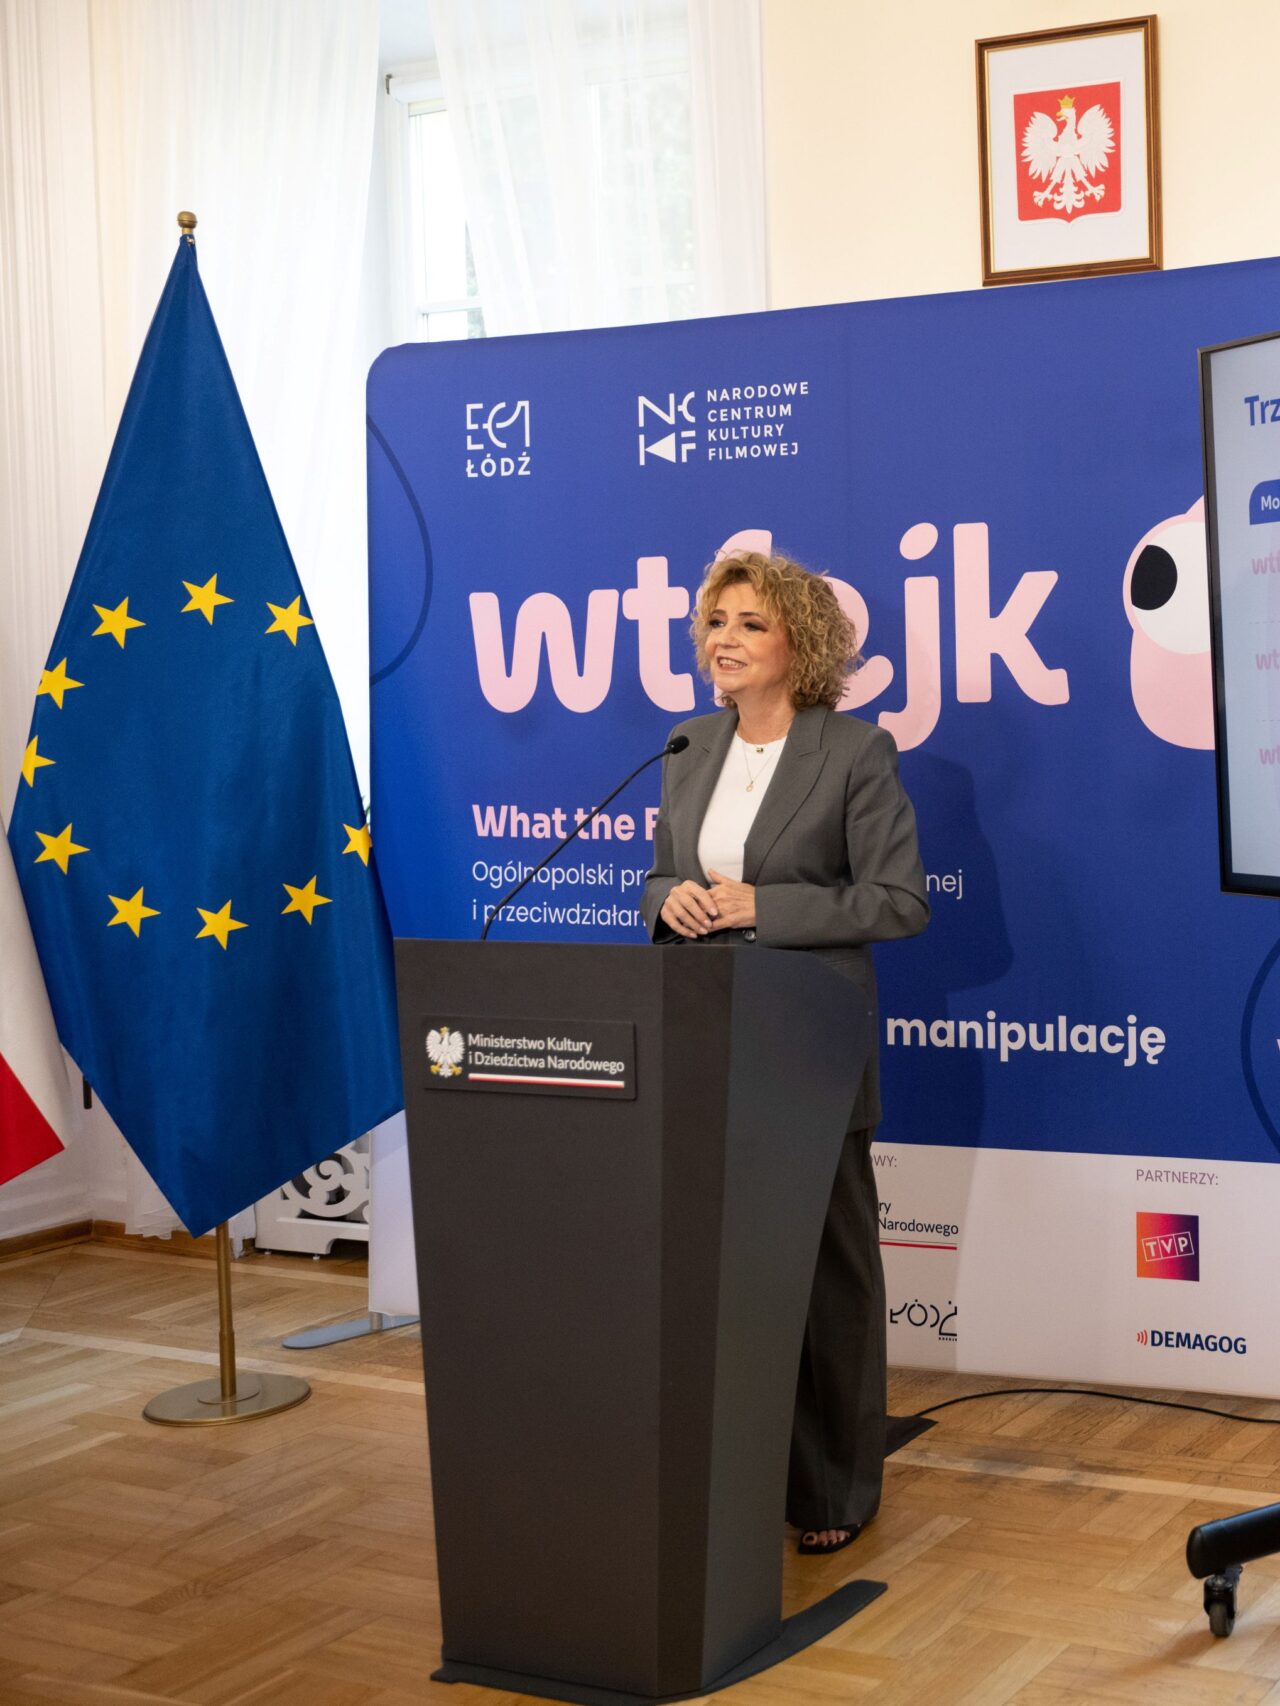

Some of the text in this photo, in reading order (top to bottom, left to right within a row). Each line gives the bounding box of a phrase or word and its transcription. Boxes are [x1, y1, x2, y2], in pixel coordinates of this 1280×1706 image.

[707, 381, 809, 402] NARODOWE
[707, 403, 792, 422] CENTRUM
[708, 424, 784, 441] KULTURY
[708, 442, 799, 461] FILMOWEJ
[466, 451, 531, 477] ŁÓDŹ
[472, 804, 567, 839] What
[574, 806, 635, 841] the
[472, 860, 613, 890] Ogólnopolski
[472, 898, 477, 920] i
[468, 1033, 592, 1054] Ministerstwo Kultury
[886, 1010, 1166, 1067] manipulację
[468, 1051, 625, 1075] i Dziedzictwa Narodowego
[1136, 1169, 1219, 1186] PARTNERZY:
[1145, 1237, 1189, 1257] TVP
[1150, 1330, 1247, 1354] DEMAGOG
